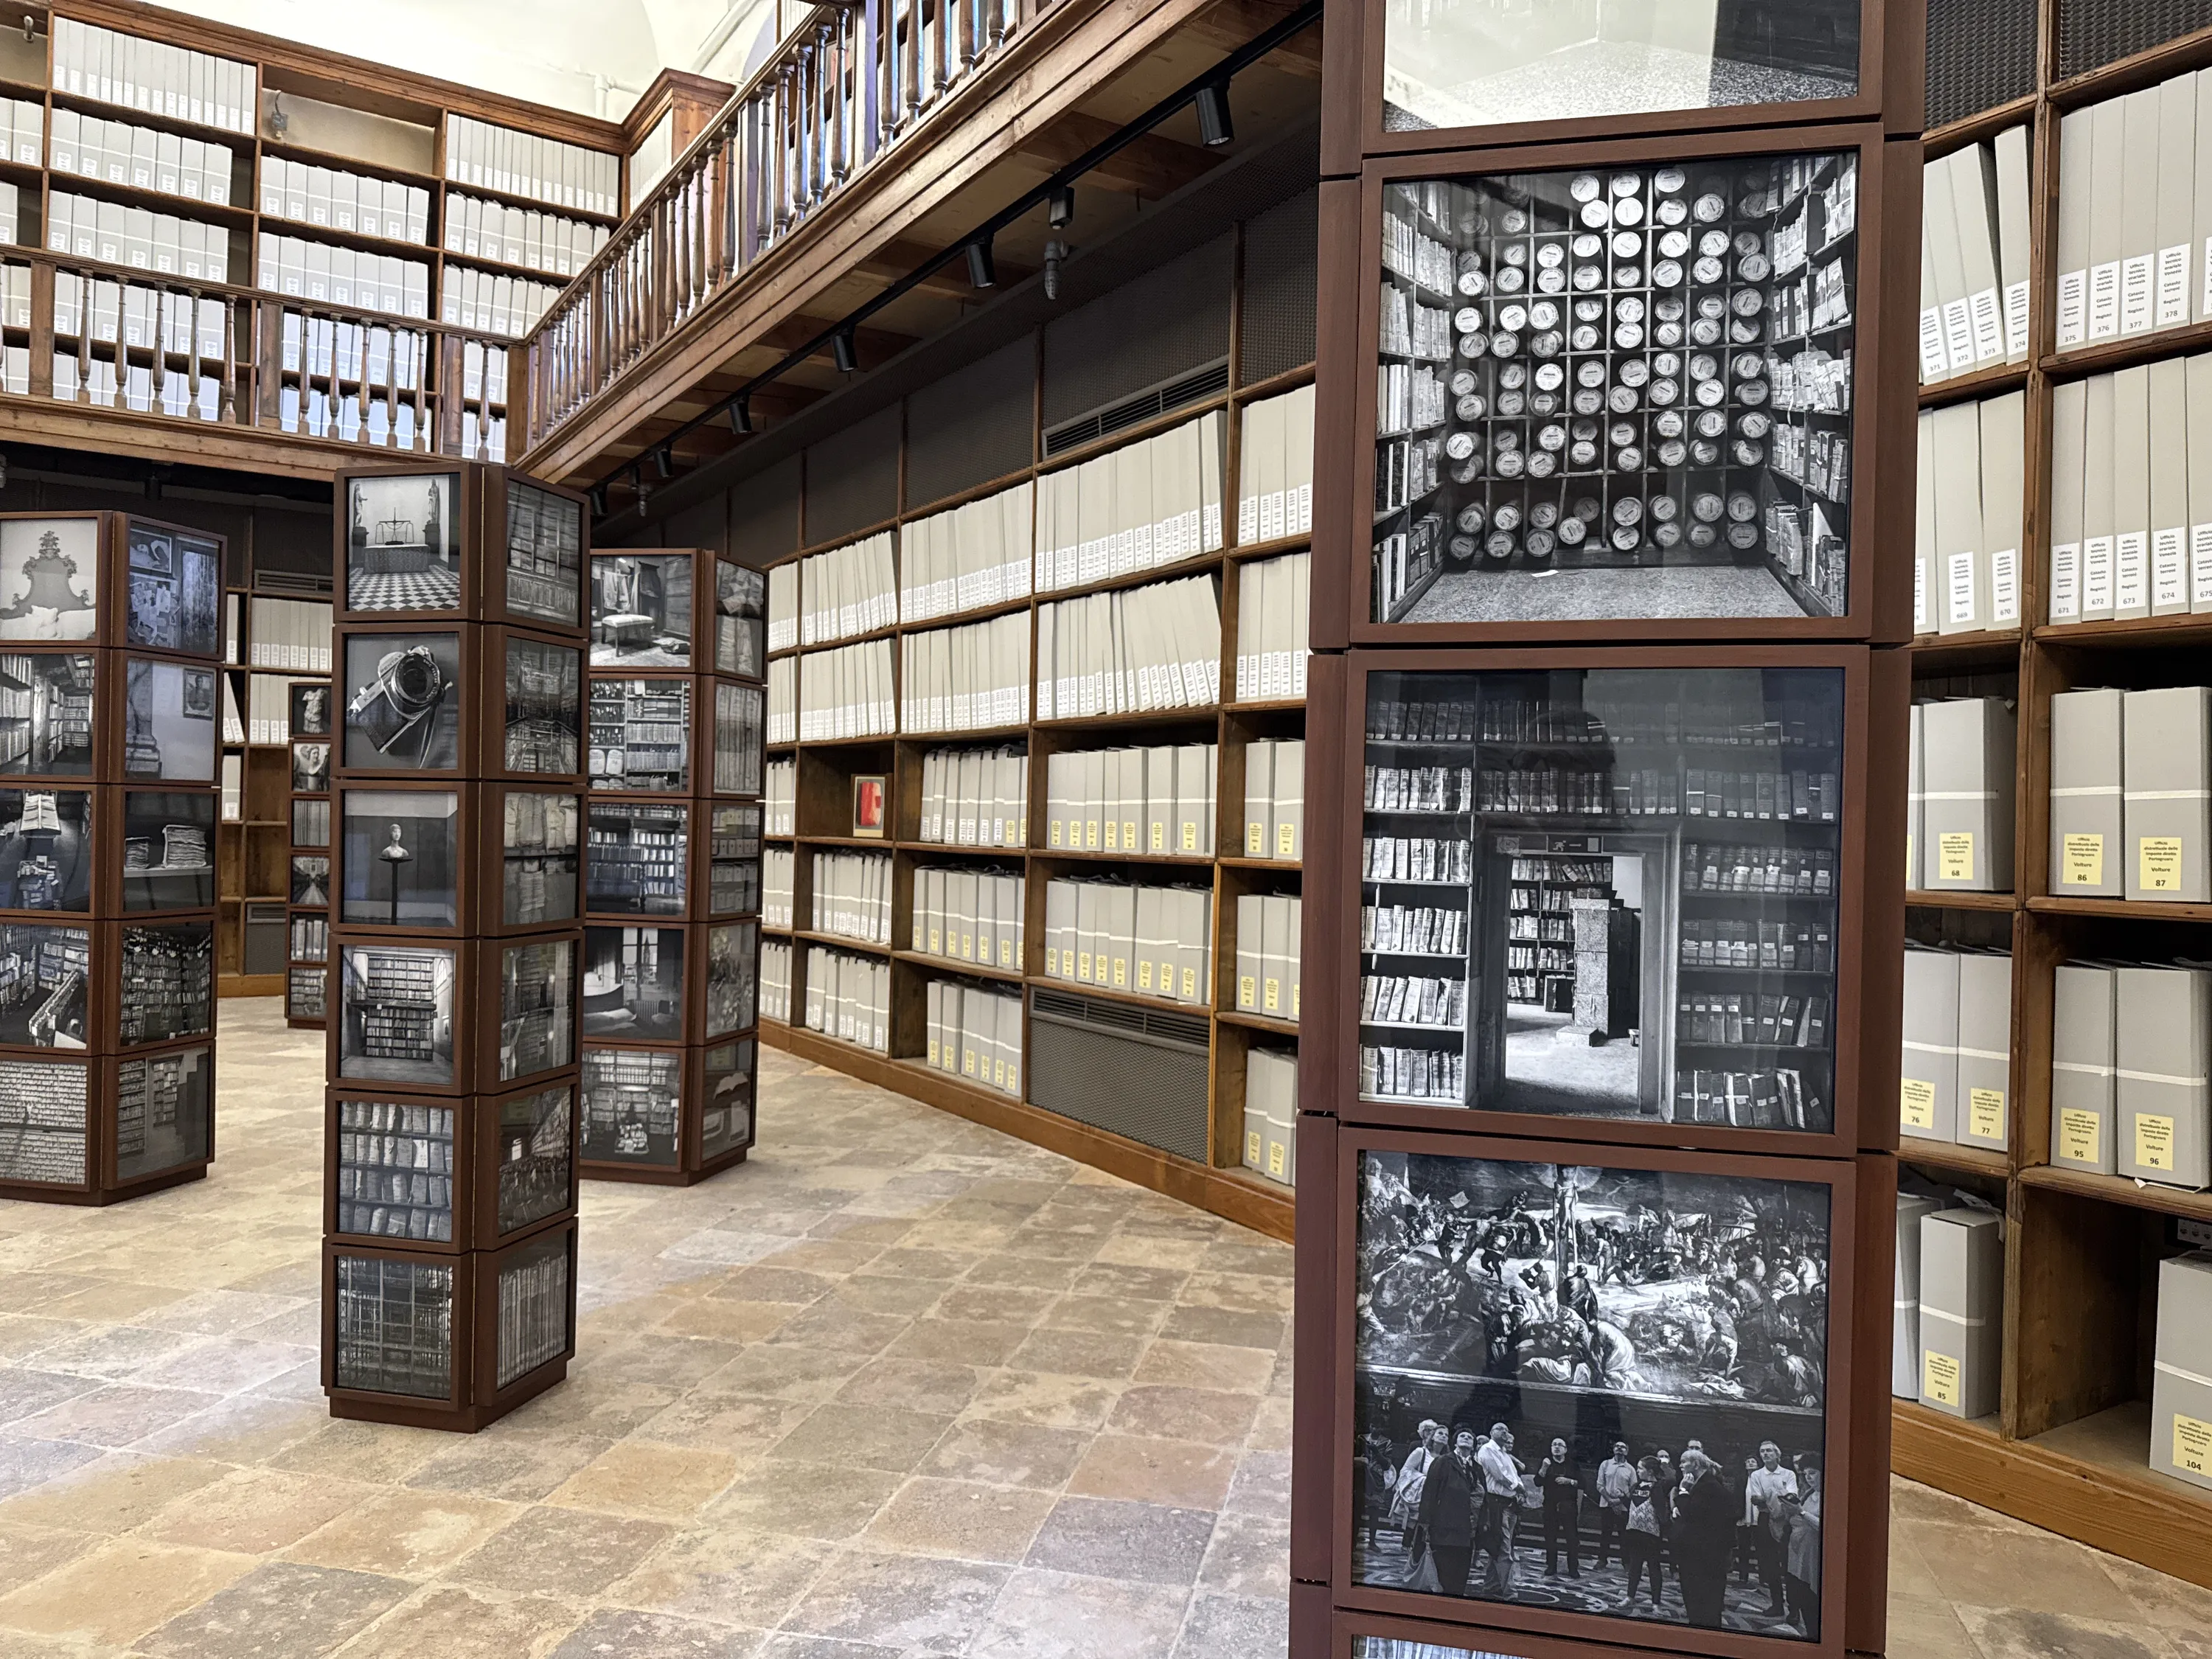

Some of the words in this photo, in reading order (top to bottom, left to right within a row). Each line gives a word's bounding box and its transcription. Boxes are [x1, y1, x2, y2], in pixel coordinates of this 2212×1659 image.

[2165, 310, 2178, 319] 378
[2097, 324, 2110, 333] 376
[2129, 321, 2143, 329] 377
[2015, 340, 2026, 349] 374
[1984, 347, 1996, 356] 373
[1957, 354, 1969, 363] 372
[1912, 1116, 1920, 1124] 76
[2074, 1150, 2084, 1158] 95
[2150, 1157, 2160, 1165] 96
[1938, 1391, 1947, 1400] 85
[2184, 1446, 2204, 1456] Volture
[2186, 1460, 2201, 1470] 104
